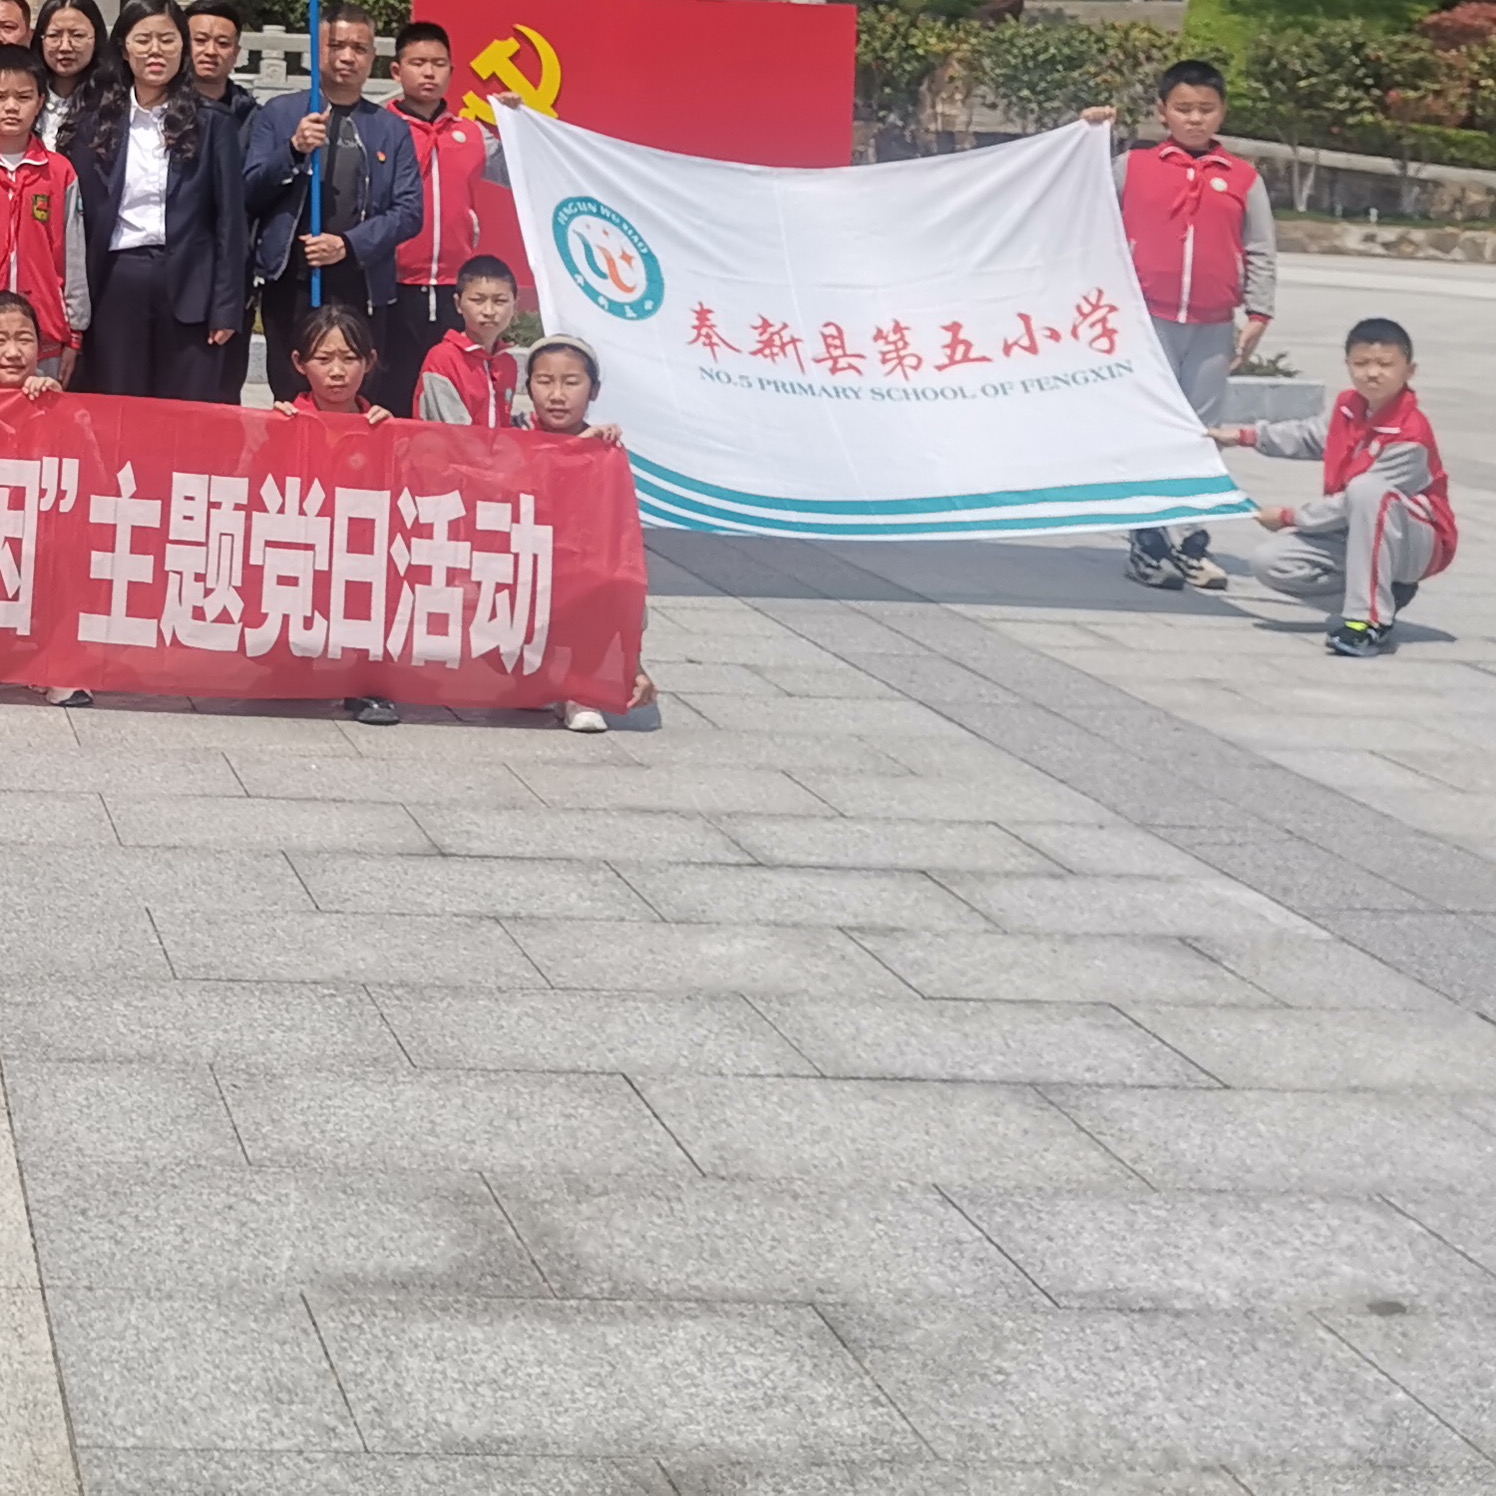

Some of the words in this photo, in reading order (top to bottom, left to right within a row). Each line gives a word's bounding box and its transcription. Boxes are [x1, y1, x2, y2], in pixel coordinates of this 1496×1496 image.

[685, 286, 1120, 382] 奉新县第五小学
[698, 365, 753, 389] NO.5
[756, 376, 863, 401] PRIMARY
[869, 384, 976, 403] SCHOOL
[980, 379, 1015, 398] OF
[1019, 358, 1135, 394] FENGXIN
